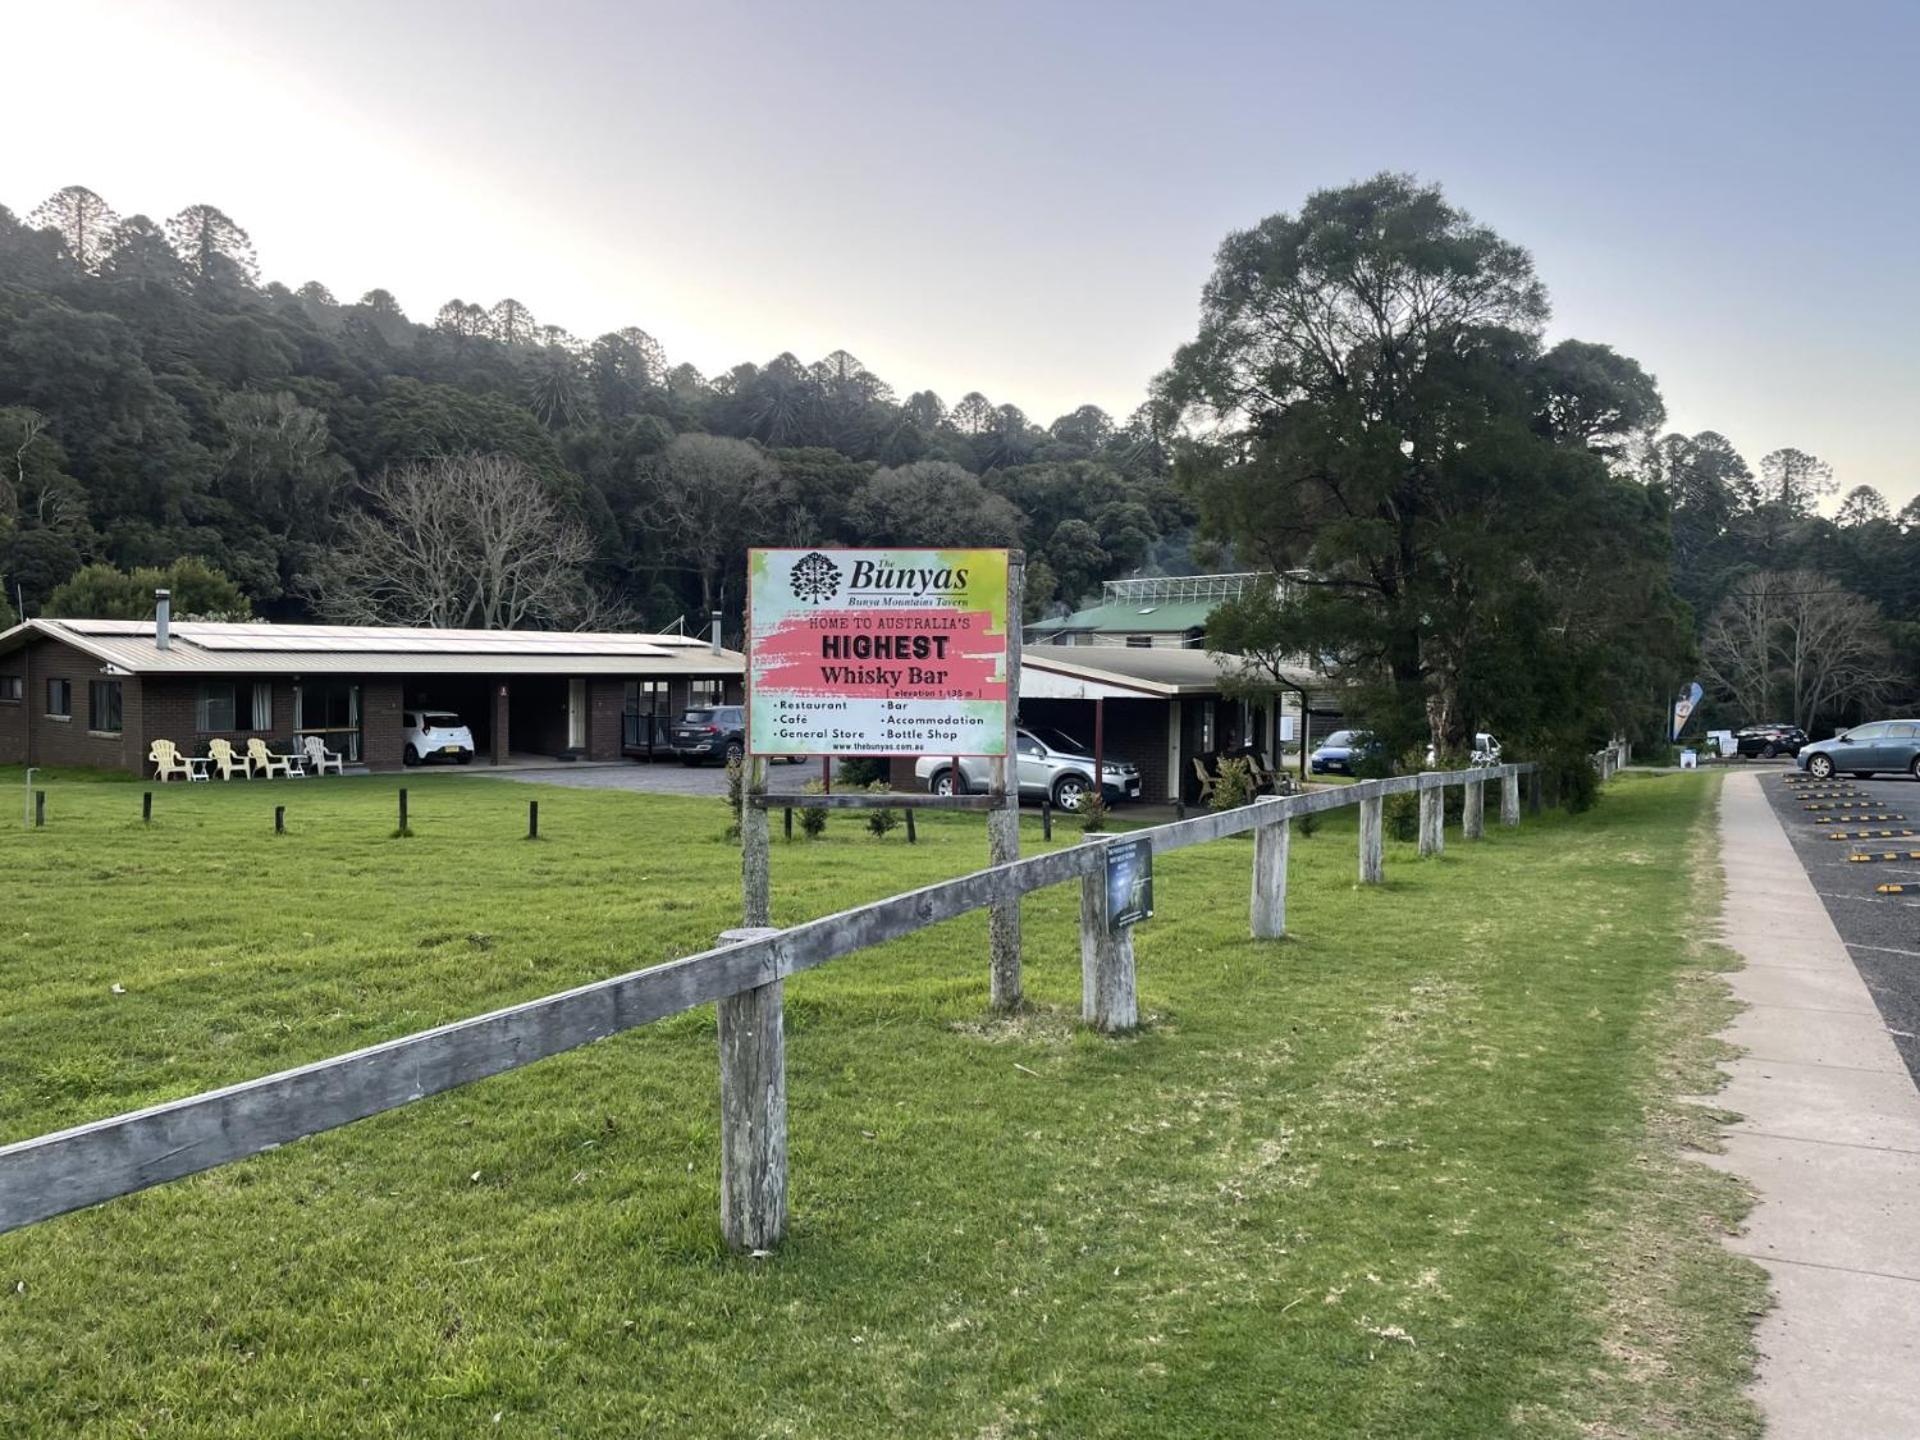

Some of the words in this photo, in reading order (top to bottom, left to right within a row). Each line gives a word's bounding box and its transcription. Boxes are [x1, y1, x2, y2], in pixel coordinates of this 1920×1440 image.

[879, 560, 895, 568] The
[848, 560, 969, 597] Bunyas
[848, 597, 880, 607] Bunya
[882, 597, 933, 607] Mountains
[936, 597, 969, 607] Tavern
[809, 618, 849, 629] HOME
[853, 618, 872, 629] TO
[878, 617, 971, 630] AUSTRALIA'S
[822, 635, 949, 660] HIGHEST
[820, 666, 903, 687] Whisky
[908, 667, 948, 685] Bar
[780, 701, 847, 710] Restaurant
[887, 701, 908, 710] Bar
[887, 715, 984, 725] Accommodation
[780, 729, 828, 739] General
[832, 729, 865, 739] Store
[887, 729, 923, 739] Bottle
[927, 729, 958, 741] Shop
[832, 742, 924, 752] www.thebunyas.com.au
